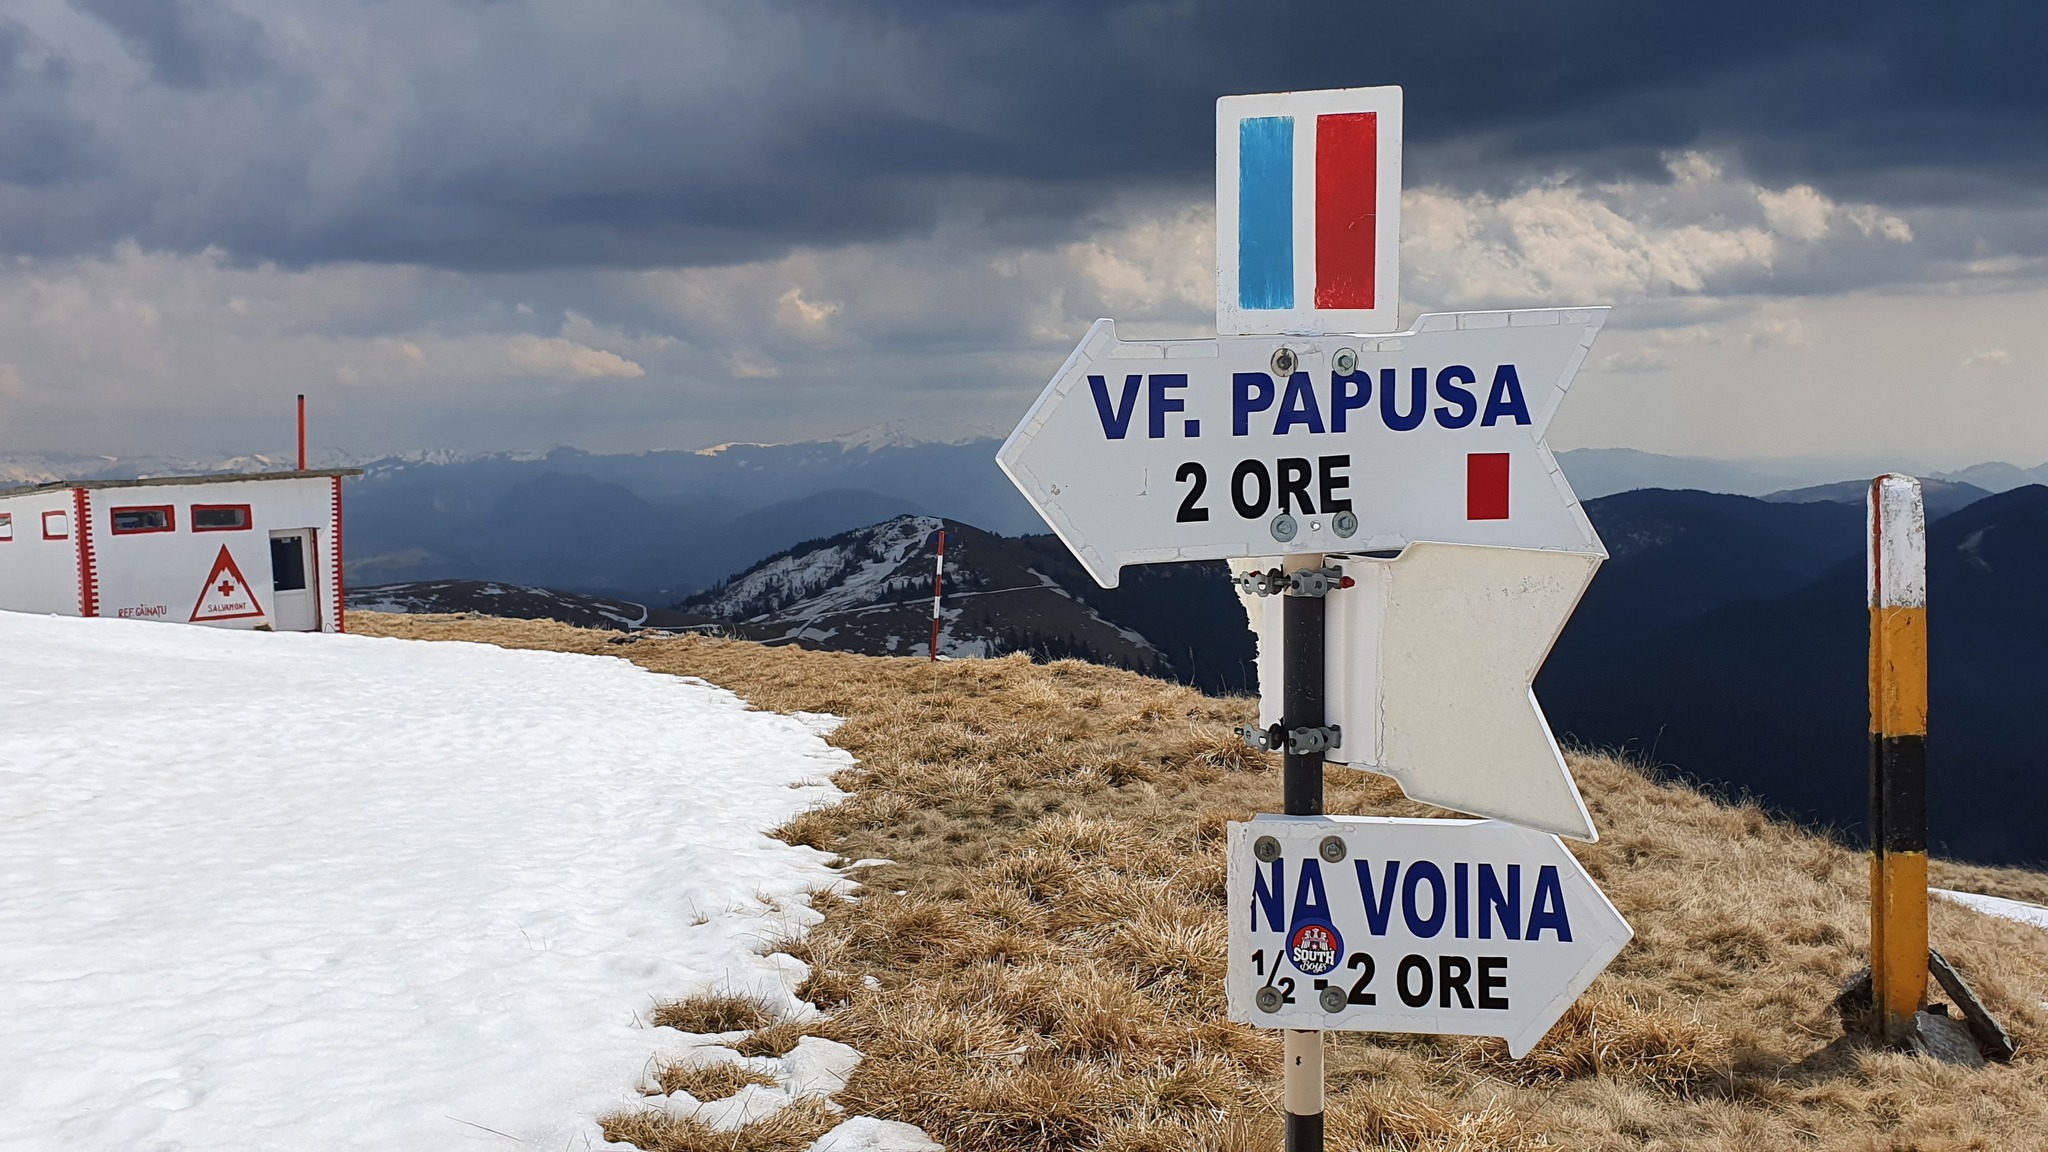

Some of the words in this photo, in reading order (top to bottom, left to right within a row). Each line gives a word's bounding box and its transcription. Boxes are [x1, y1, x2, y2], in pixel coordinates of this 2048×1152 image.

[1087, 374, 1200, 439] VF.
[1233, 364, 1532, 437] PAPUSA
[1176, 461, 1210, 523] 2
[1231, 455, 1353, 518] ORE
[118, 607, 134, 618] REF.
[207, 602, 246, 613] SALVAMONT
[1354, 859, 1574, 943] VOINA
[1293, 947, 1335, 966] SOUTH
[1300, 960, 1327, 973] Boys
[1346, 952, 1377, 1006] 2
[1397, 954, 1510, 1010] ORE
